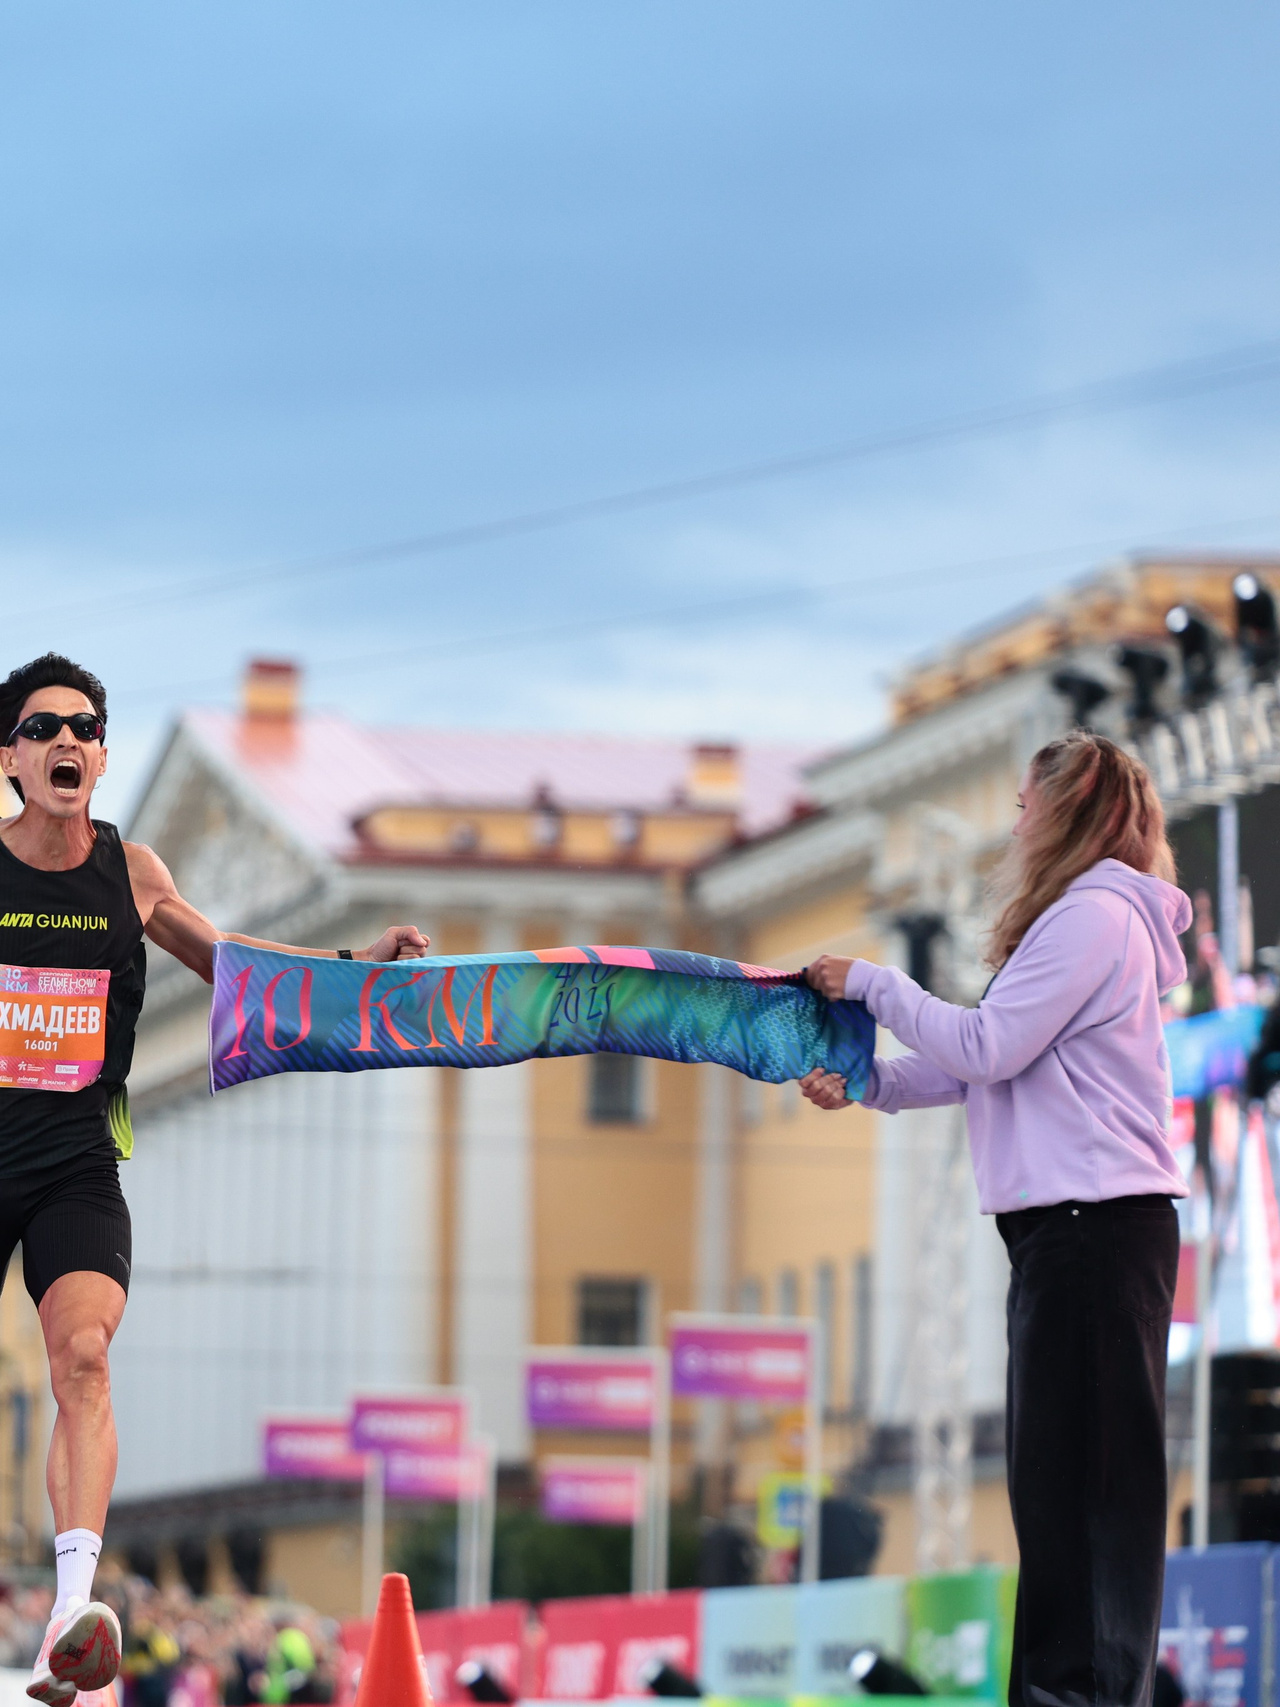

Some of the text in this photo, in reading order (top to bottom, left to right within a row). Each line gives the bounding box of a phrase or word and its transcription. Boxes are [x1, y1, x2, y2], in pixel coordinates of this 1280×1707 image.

[36, 913, 108, 931] GUANJUN
[5, 967, 22, 979] 10
[38, 976, 97, 988] БЕЛЫЕ НОЧИ
[38, 985, 87, 995] МАРАФОН
[223, 964, 313, 1061] 10
[24, 1039, 58, 1052] 16001
